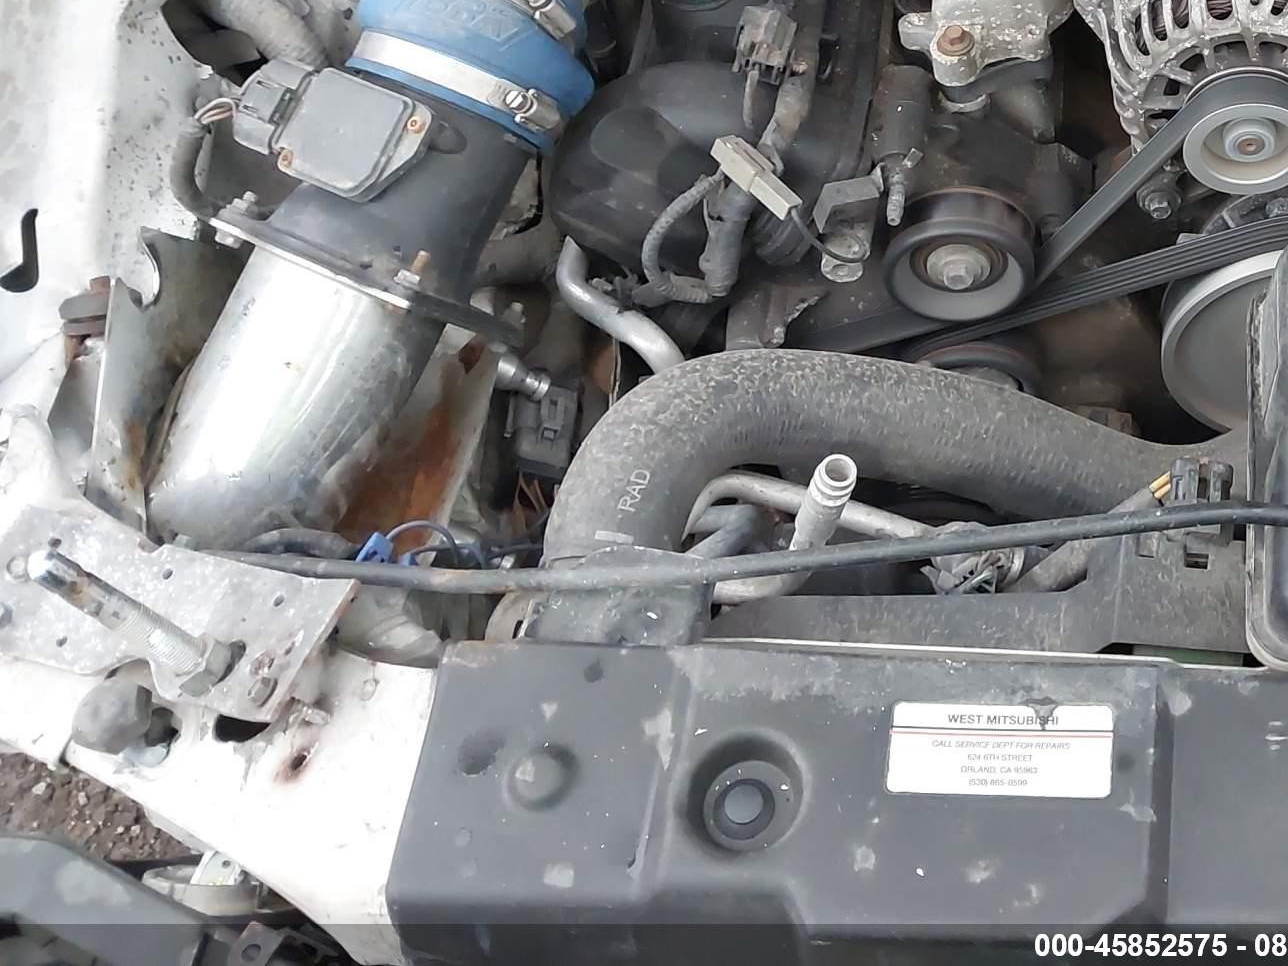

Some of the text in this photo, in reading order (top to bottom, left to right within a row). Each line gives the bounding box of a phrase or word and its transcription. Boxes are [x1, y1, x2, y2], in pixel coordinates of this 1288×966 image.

[616, 469, 651, 512] RAD
[948, 714, 1059, 726] WEST MITSUBISHI
[932, 739, 1071, 750] CALL SERVICE DEPT FOR REPAIRS
[1001, 754, 1033, 762] STREET
[1000, 766, 1012, 774] CA
